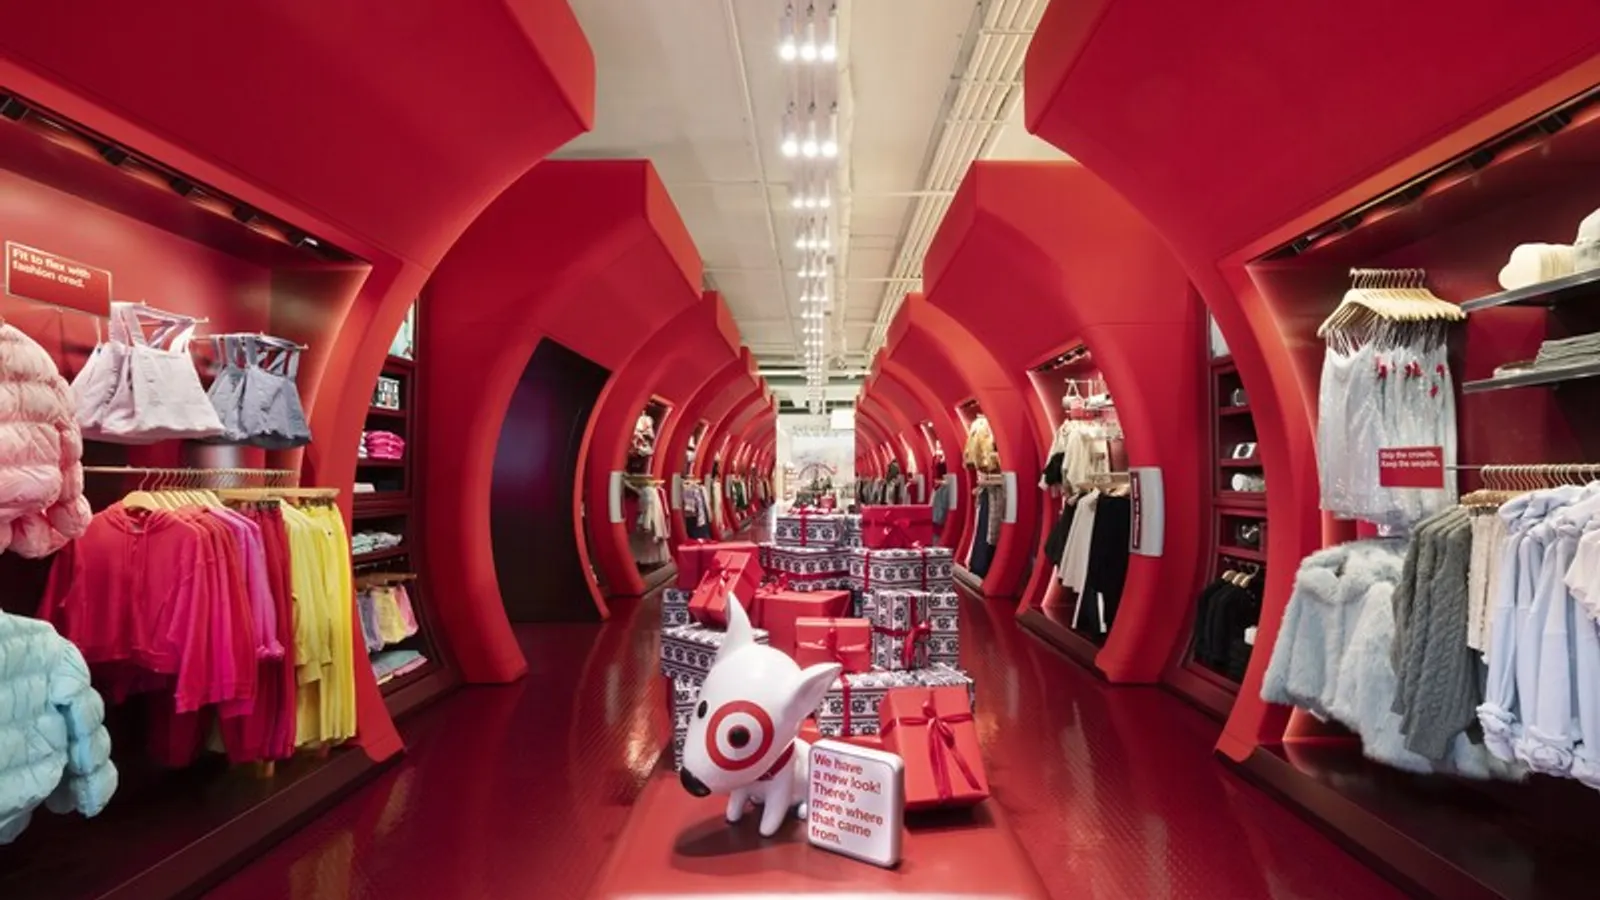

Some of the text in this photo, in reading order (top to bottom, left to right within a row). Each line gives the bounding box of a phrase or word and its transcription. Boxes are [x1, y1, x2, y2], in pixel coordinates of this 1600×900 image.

[13, 248, 29, 261] Fit
[31, 254, 43, 265] to
[68, 266, 91, 279] with
[13, 260, 56, 280] fashion
[1396, 451, 1407, 459] the
[1398, 460, 1409, 468] the
[813, 753, 863, 775] We have
[813, 770, 882, 795] a new look!
[813, 781, 855, 803] There's
[812, 798, 883, 826] more where
[812, 811, 871, 838] that came
